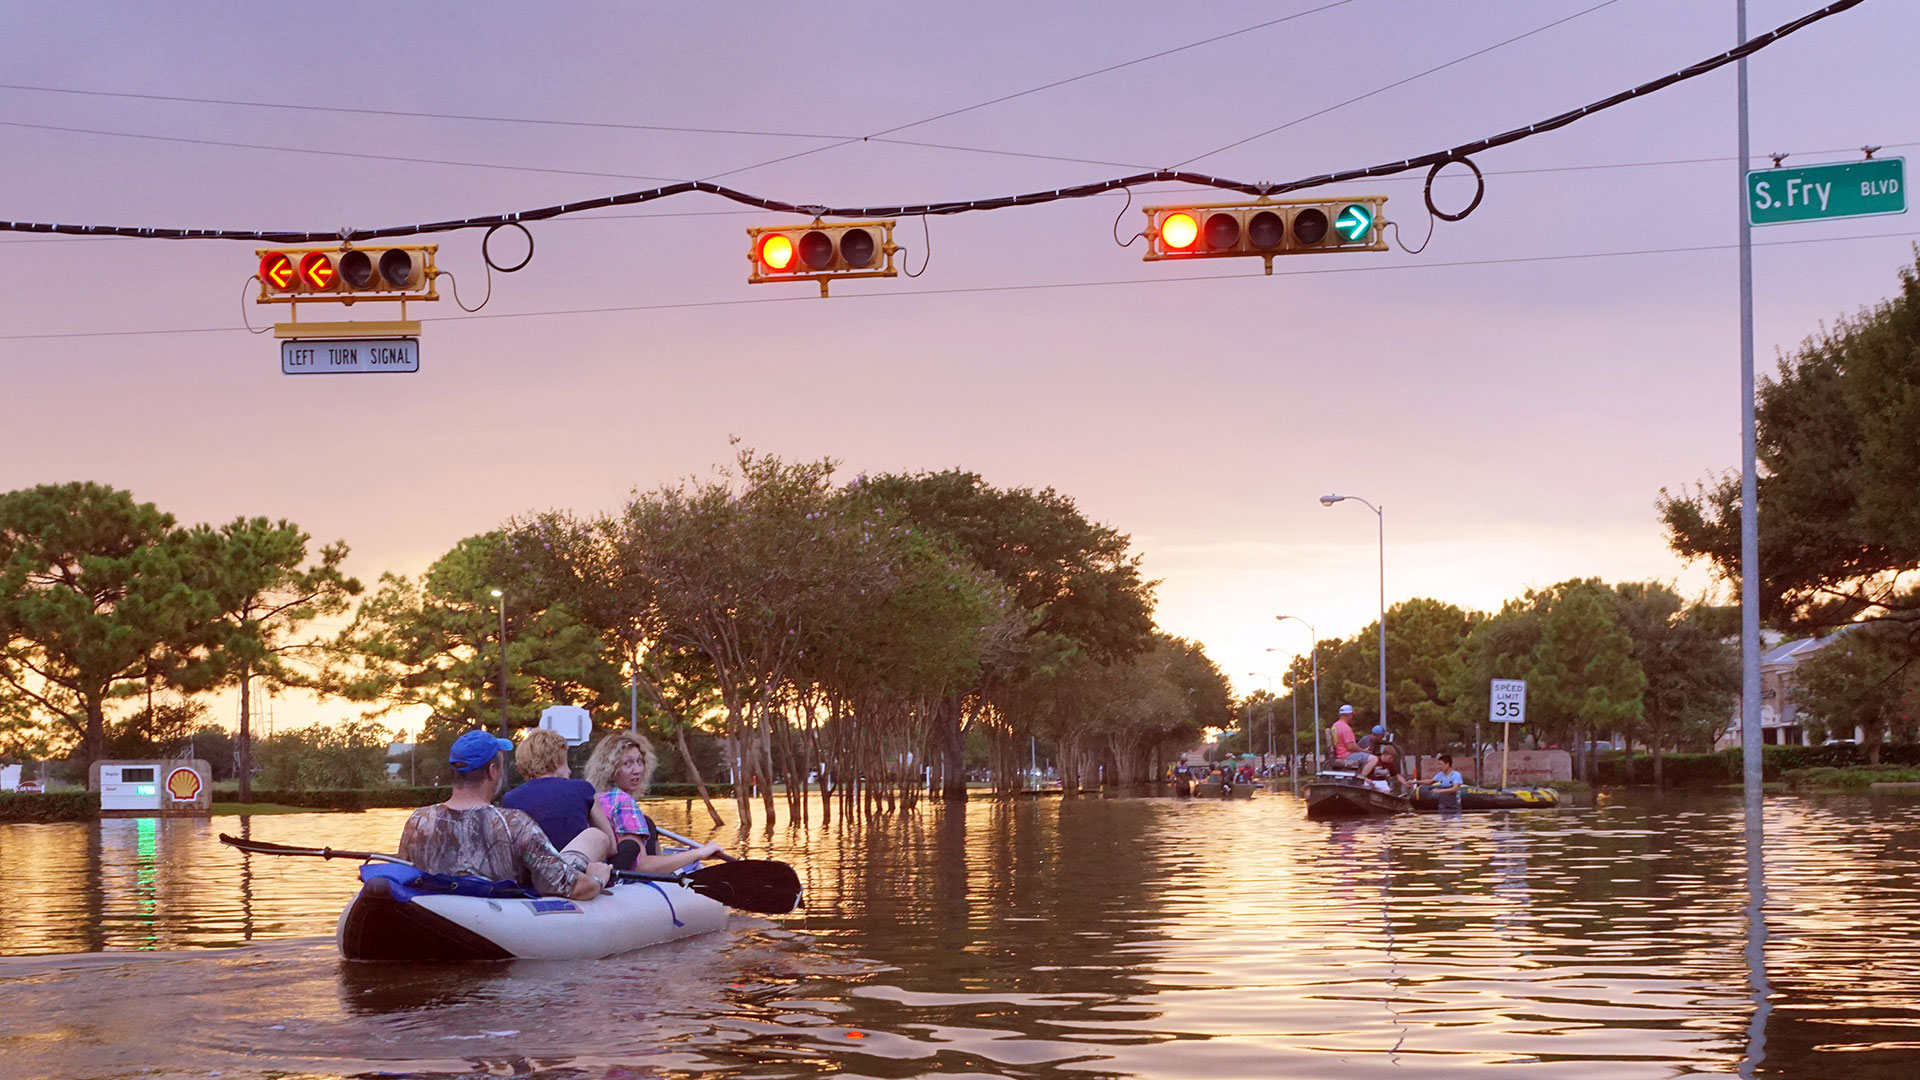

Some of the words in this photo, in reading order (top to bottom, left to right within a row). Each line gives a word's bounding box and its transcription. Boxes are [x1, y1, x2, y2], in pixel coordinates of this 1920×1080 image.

[1787, 178, 1832, 211] Fry
[1861, 179, 1899, 197] BLVD
[289, 349, 315, 366] LEFT
[328, 348, 358, 365] TURN
[370, 347, 412, 364] SIGNAL
[1494, 684, 1523, 692] SPEED
[1495, 701, 1520, 717] 35
